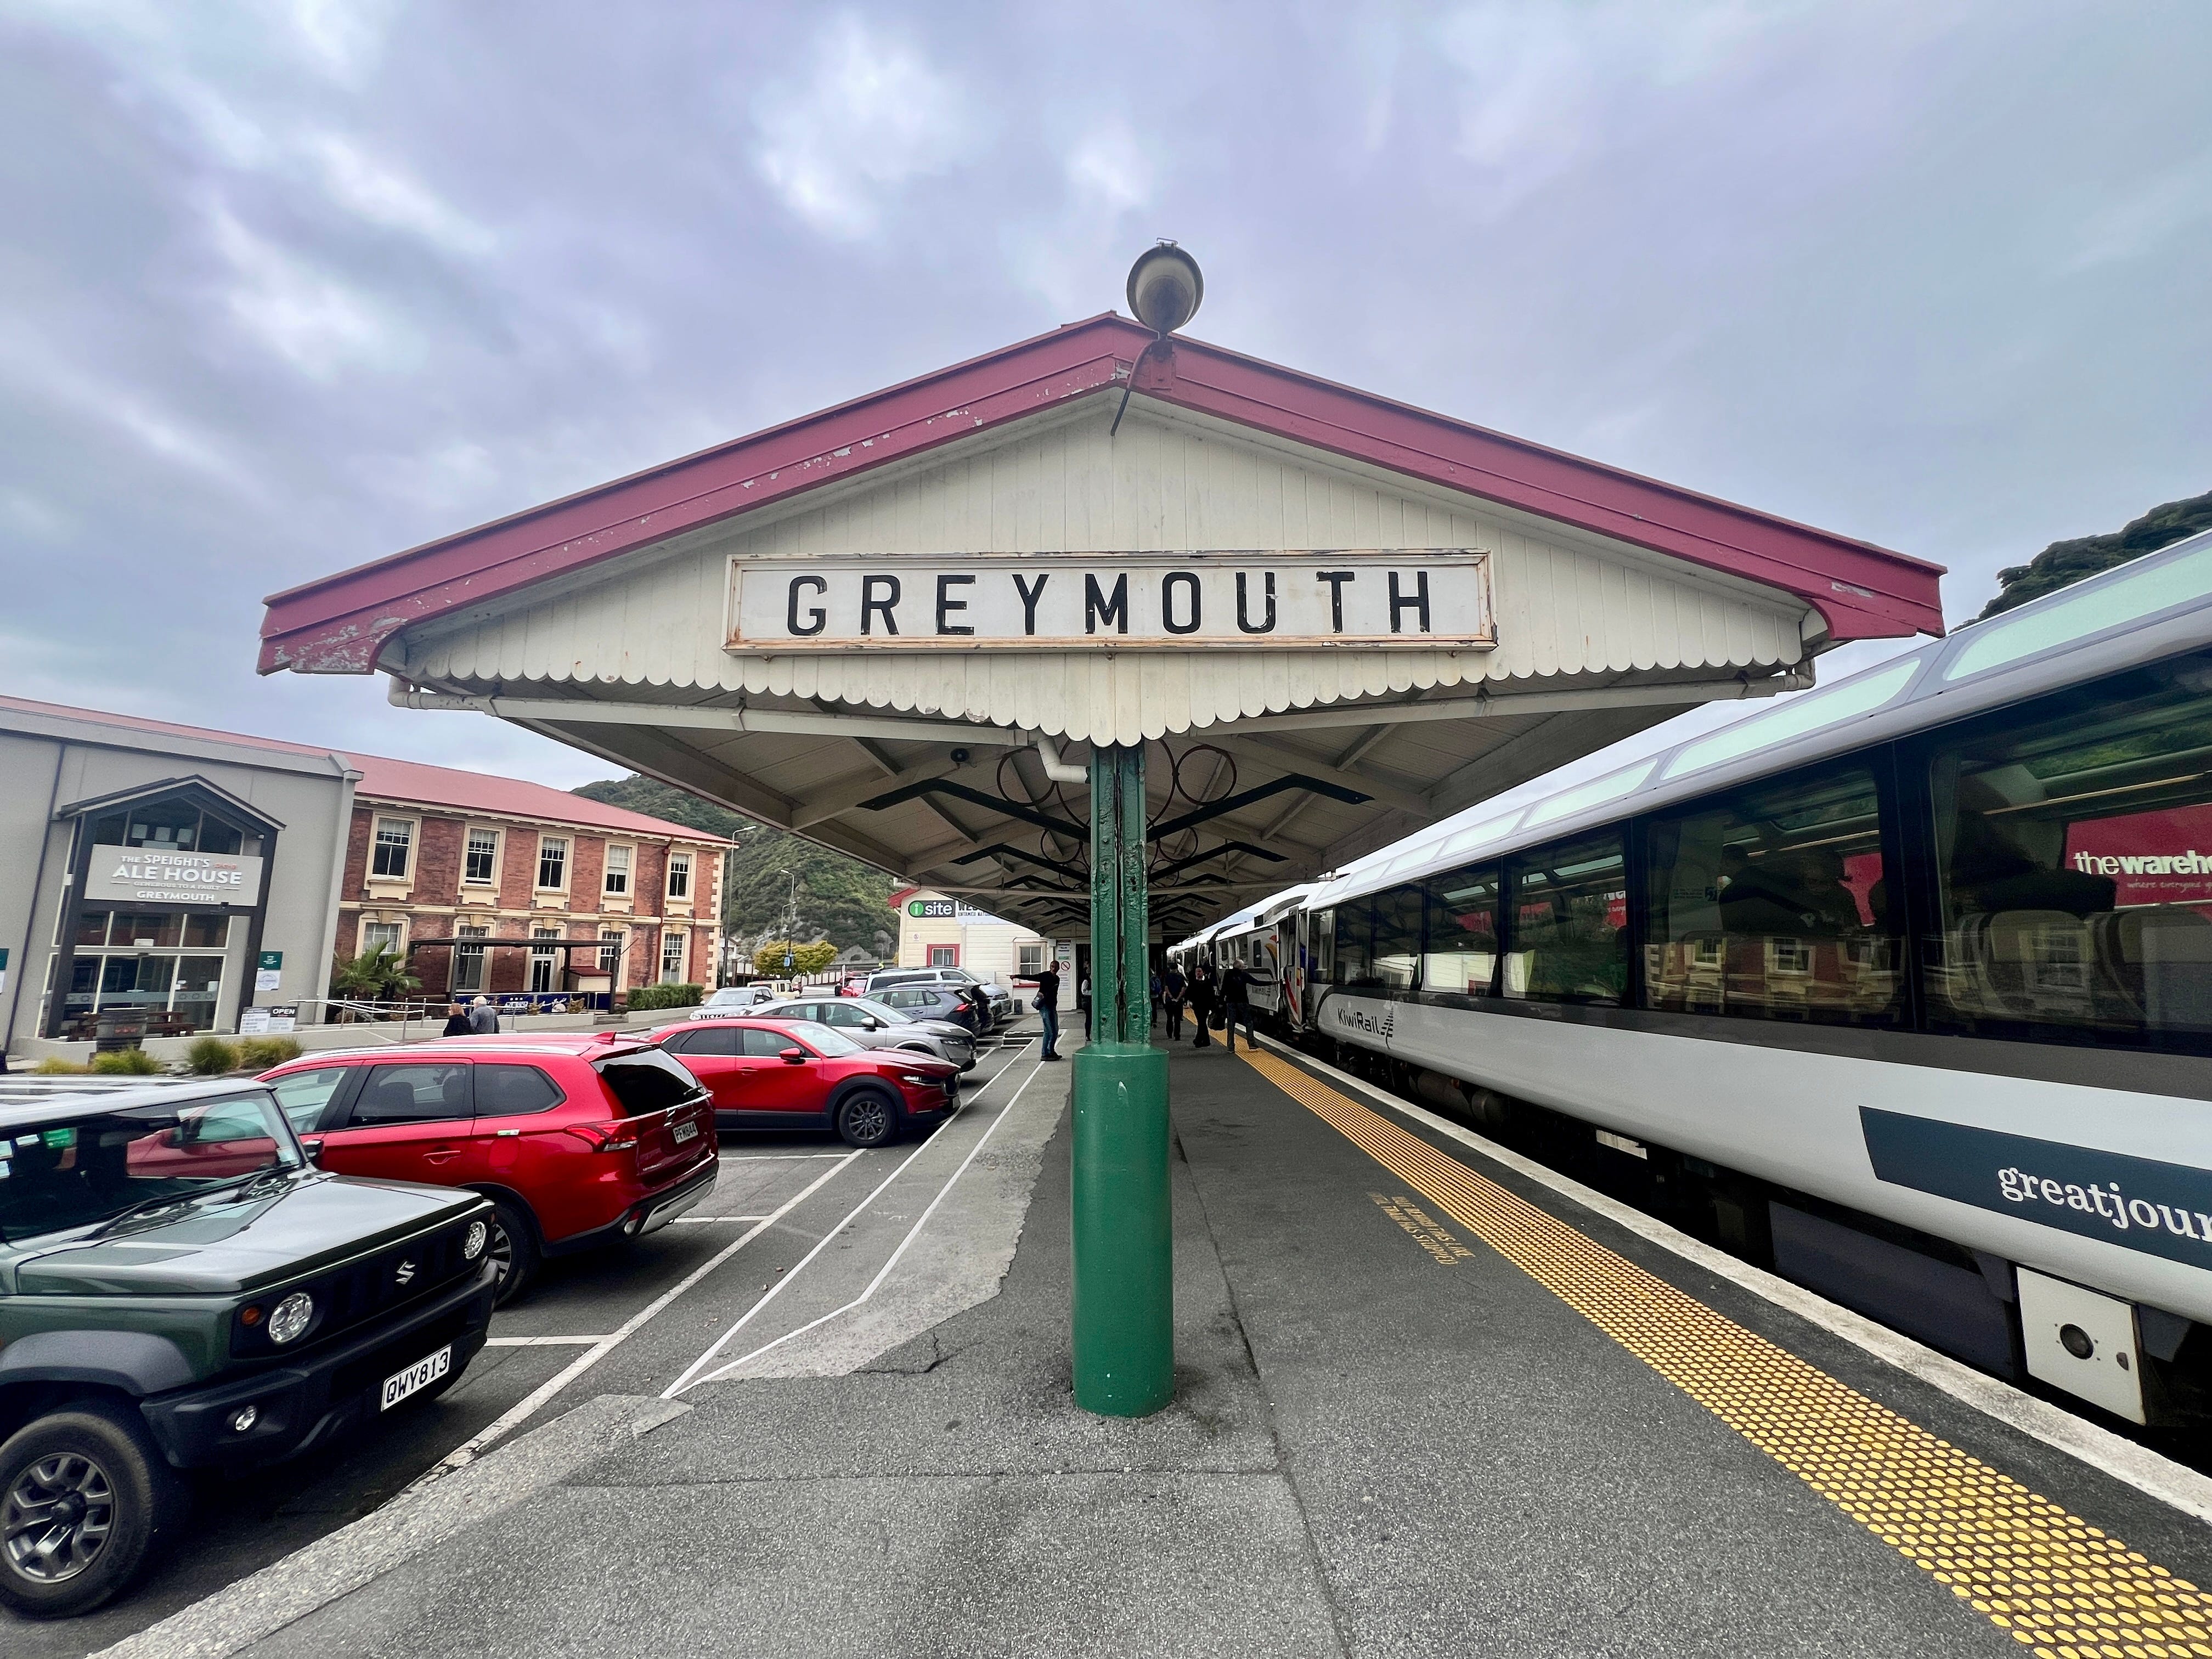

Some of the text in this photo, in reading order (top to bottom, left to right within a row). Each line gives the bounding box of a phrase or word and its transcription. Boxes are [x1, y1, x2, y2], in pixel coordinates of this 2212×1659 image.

[787, 572, 1430, 635] GREYMOUTH
[143, 854, 210, 867] SPEIGHT'S
[2073, 850, 2212, 874] thewareh
[111, 865, 242, 884] ALE HOUSE
[137, 890, 215, 901] GREYMOUTH
[925, 901, 952, 915] site
[1338, 1008, 1380, 1035] KiwiRail
[386, 1351, 448, 1404] QWY813
